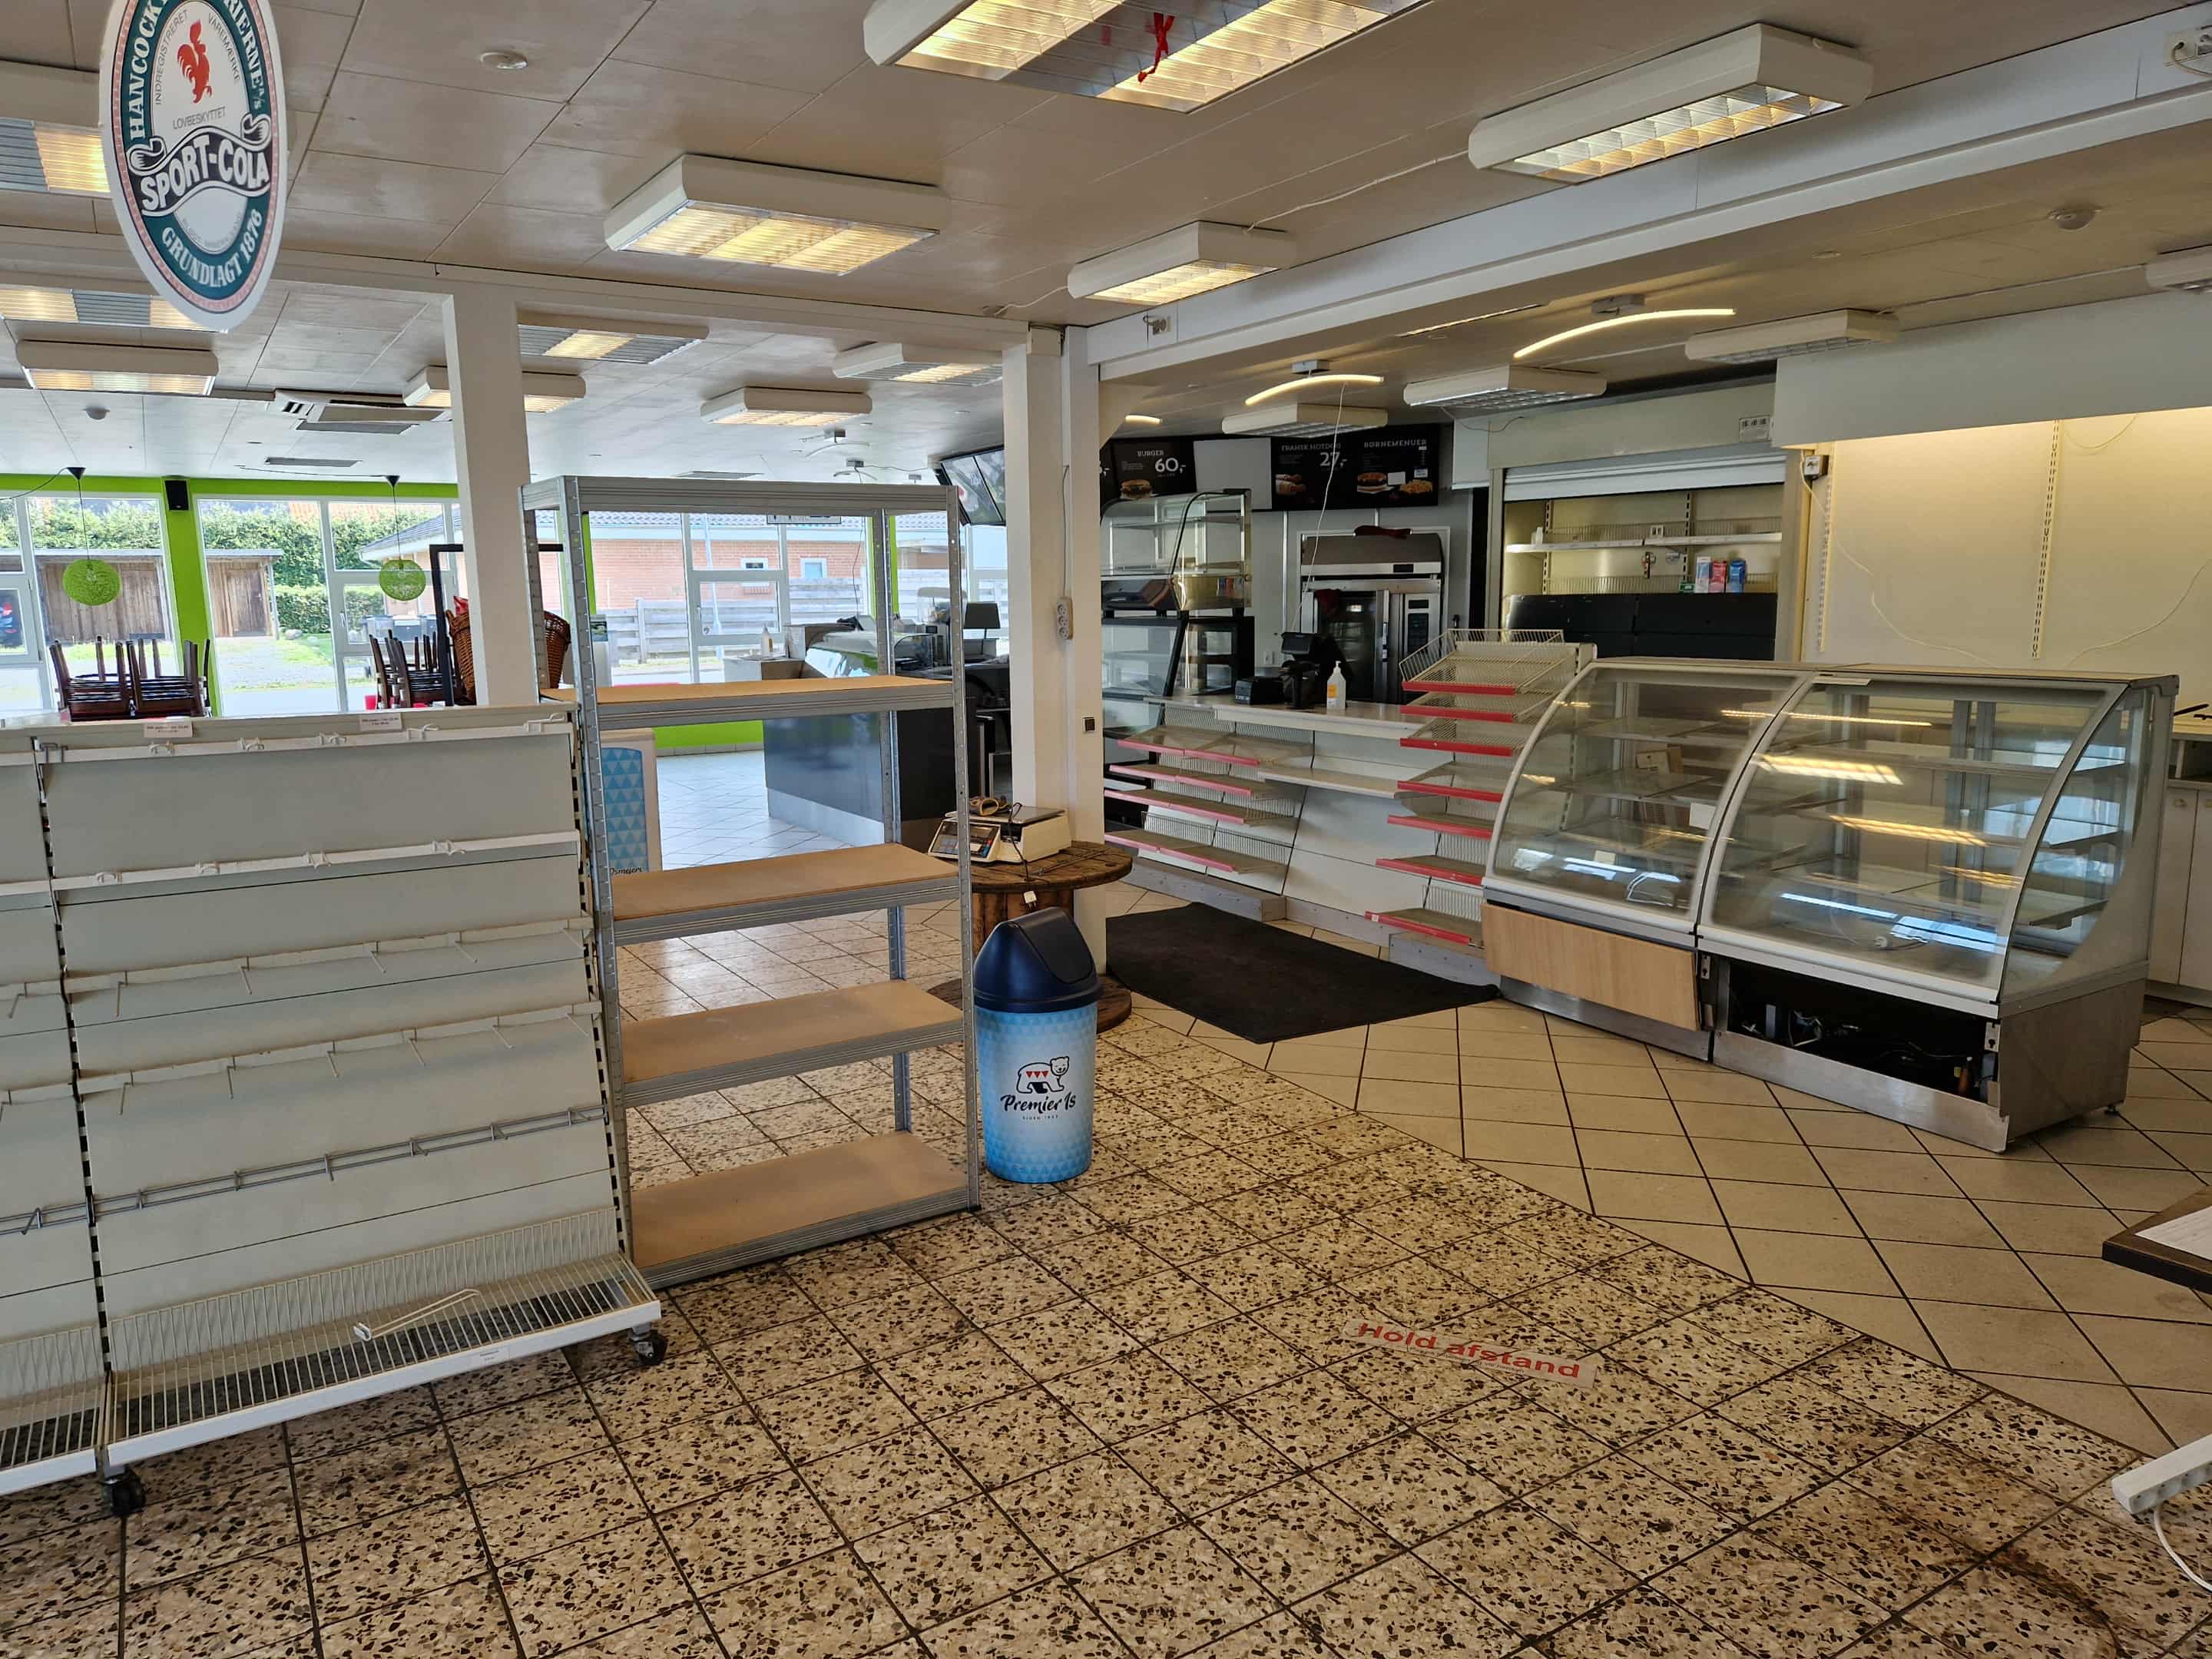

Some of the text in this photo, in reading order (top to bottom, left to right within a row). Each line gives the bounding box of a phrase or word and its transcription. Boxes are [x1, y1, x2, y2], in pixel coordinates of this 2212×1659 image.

[129, 0, 167, 140] HANCOCK
[155, 9, 189, 105] INDREGISTRERET
[208, 12, 241, 83] VAREMÆRKE
[173, 106, 227, 130] LOVBESKYTTET
[141, 134, 270, 210] SPORT-COLA
[162, 227, 243, 288] GRUNDLAGT
[240, 209, 263, 263] 1876
[1154, 458, 1186, 473] 60,-
[1000, 1091, 1076, 1114] Premier Is
[1357, 1322, 1436, 1349] Hold
[1446, 1344, 1580, 1379] afstand
